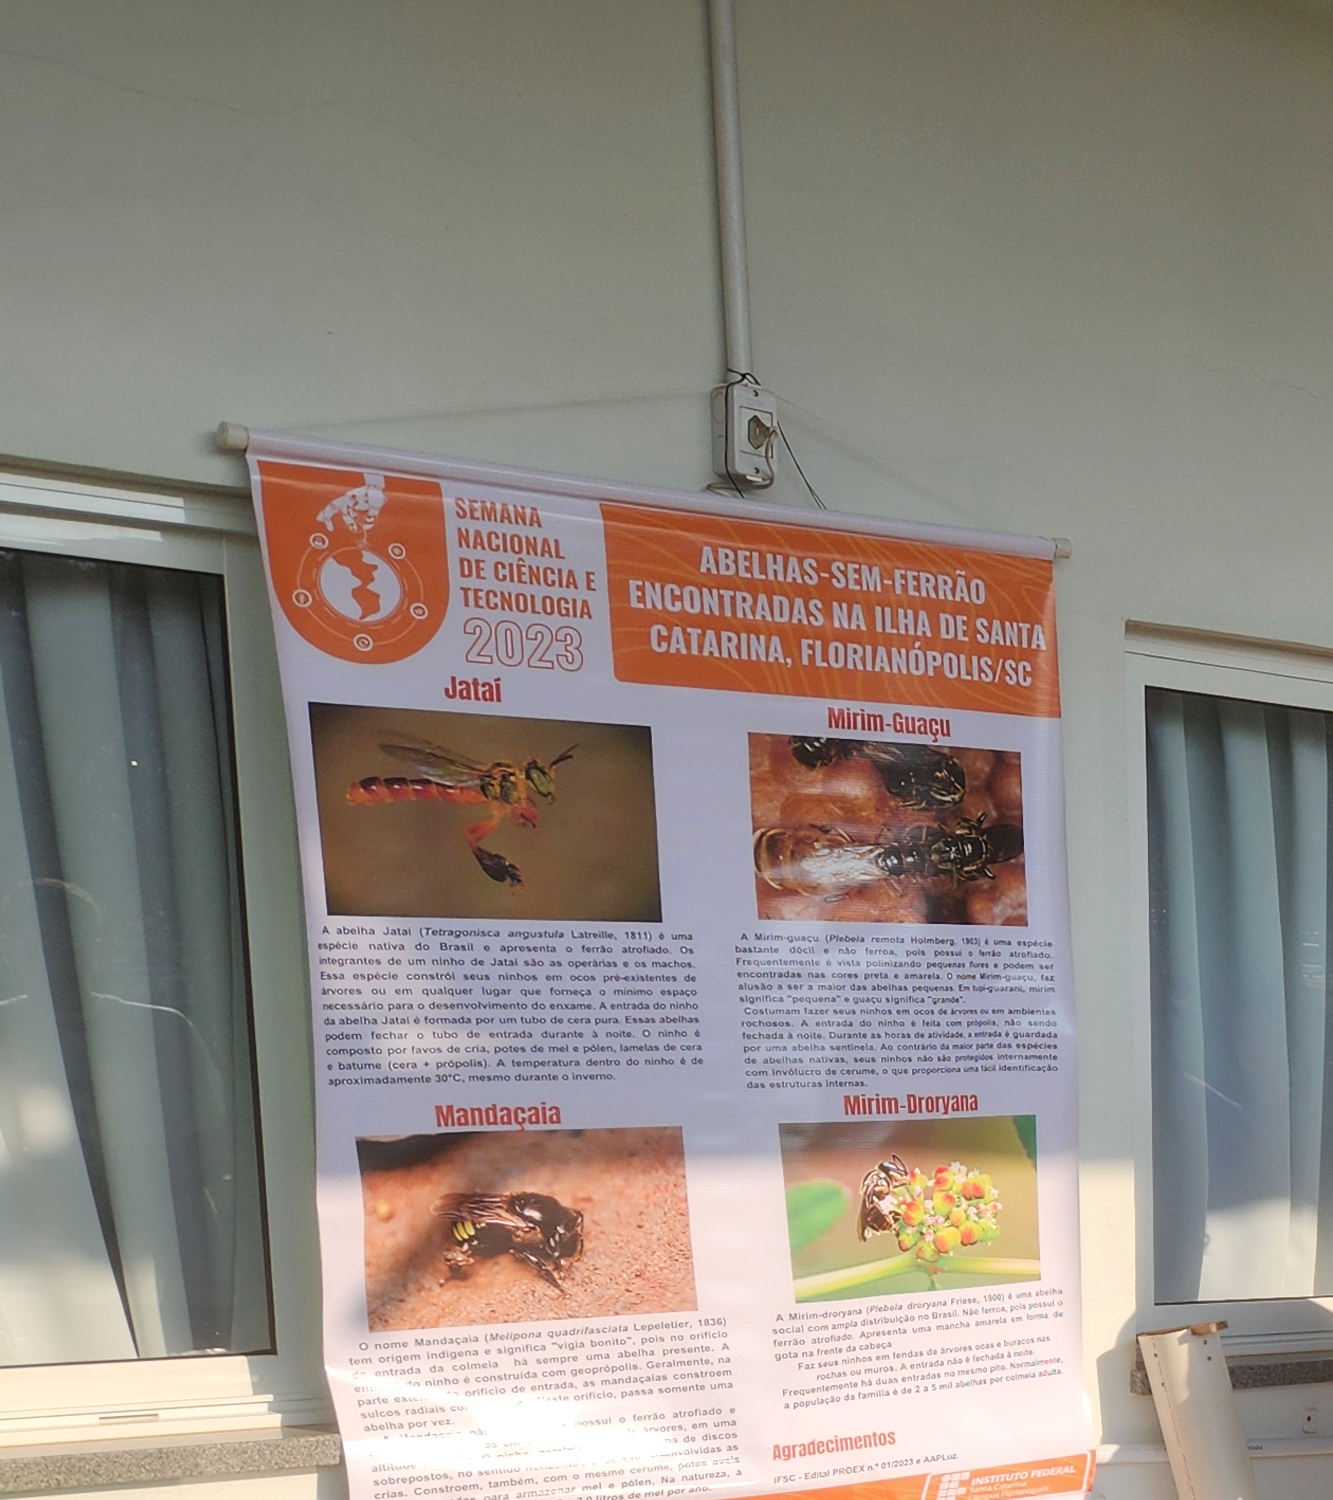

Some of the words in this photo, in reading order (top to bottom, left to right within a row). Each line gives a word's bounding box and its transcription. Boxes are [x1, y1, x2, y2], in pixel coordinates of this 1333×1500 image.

[455, 497, 542, 528] SEMANA
[457, 527, 565, 558] NACIONAL
[459, 557, 486, 580] DE
[493, 557, 578, 589] CIÊNCIA
[585, 571, 596, 591] E
[700, 546, 985, 604] ABELHAS-SEM-FERRÃO
[459, 586, 592, 619] TECNOLOGIA
[629, 579, 824, 626] ENCONTRADAS
[832, 601, 866, 630] NA
[874, 605, 931, 637] ILHA
[939, 613, 968, 641] DE
[975, 617, 1047, 650] SANTA
[463, 616, 583, 672] 2023
[650, 624, 792, 667] CATARINA,
[801, 638, 1032, 686] FLORIANÓPOLIS/SC
[444, 675, 501, 702] Jataí
[827, 707, 950, 741] Mirim-Guaçu
[317, 940, 358, 951] espécie
[368, 941, 404, 950] nativa
[414, 941, 430, 951] do
[439, 942, 473, 951] Brasil
[499, 944, 556, 954] apresenta
[581, 944, 613, 953] ferrão
[679, 945, 694, 954] Os
[321, 925, 329, 934] A
[336, 925, 375, 935] abelha
[419, 926, 500, 939] (Tetragonisca
[507, 930, 564, 940] angustula
[570, 930, 617, 940] Latreille,
[624, 930, 652, 942] 1811)
[658, 932, 664, 940] é
[740, 932, 748, 940] A
[754, 932, 819, 943] Mirim-guaçu
[1016, 939, 1052, 948] espécie
[328, 1075, 431, 1087] aproximadamente
[468, 1074, 511, 1082] mesmo
[514, 1073, 558, 1081] durante
[561, 1073, 569, 1081] o
[571, 1072, 615, 1080] inverno.
[769, 1080, 822, 1088] estruturas
[825, 1079, 867, 1087] internas.
[434, 1101, 563, 1132] Mandaçaia
[843, 1093, 979, 1117] Mirim-Droryana
[358, 1342, 369, 1351] O
[374, 1341, 408, 1349] nome
[414, 1334, 479, 1346] Mandaçaia
[484, 1331, 541, 1343] (Melipona
[547, 1324, 628, 1339] quadrifasciata
[633, 1320, 692, 1332] Lepeletier,
[697, 1316, 726, 1327] 1836)
[792, 1396, 841, 1410] população
[843, 1393, 855, 1401] da
[858, 1389, 890, 1399] família
[900, 1386, 912, 1394] de
[914, 1384, 920, 1393] 2
[931, 1383, 936, 1391] 5
[939, 1381, 952, 1390] mil
[955, 1378, 987, 1388] abelhas
[989, 1376, 1003, 1385] por
[364, 1421, 404, 1432] abelha
[407, 1420, 427, 1430] por
[430, 1418, 454, 1426] vez.
[773, 1431, 895, 1461] Agradecimentos
[773, 1474, 795, 1484] IFSC
[804, 1469, 830, 1480] Edital
[832, 1464, 864, 1476] PROEX
[880, 1457, 913, 1469] 01/2023
[972, 1471, 1028, 1486] INSTITUTO
[1031, 1465, 1076, 1478] FEDERAL
[644, 1489, 663, 1497] mel
[666, 1488, 685, 1497] por
[970, 1485, 993, 1493] Santa
